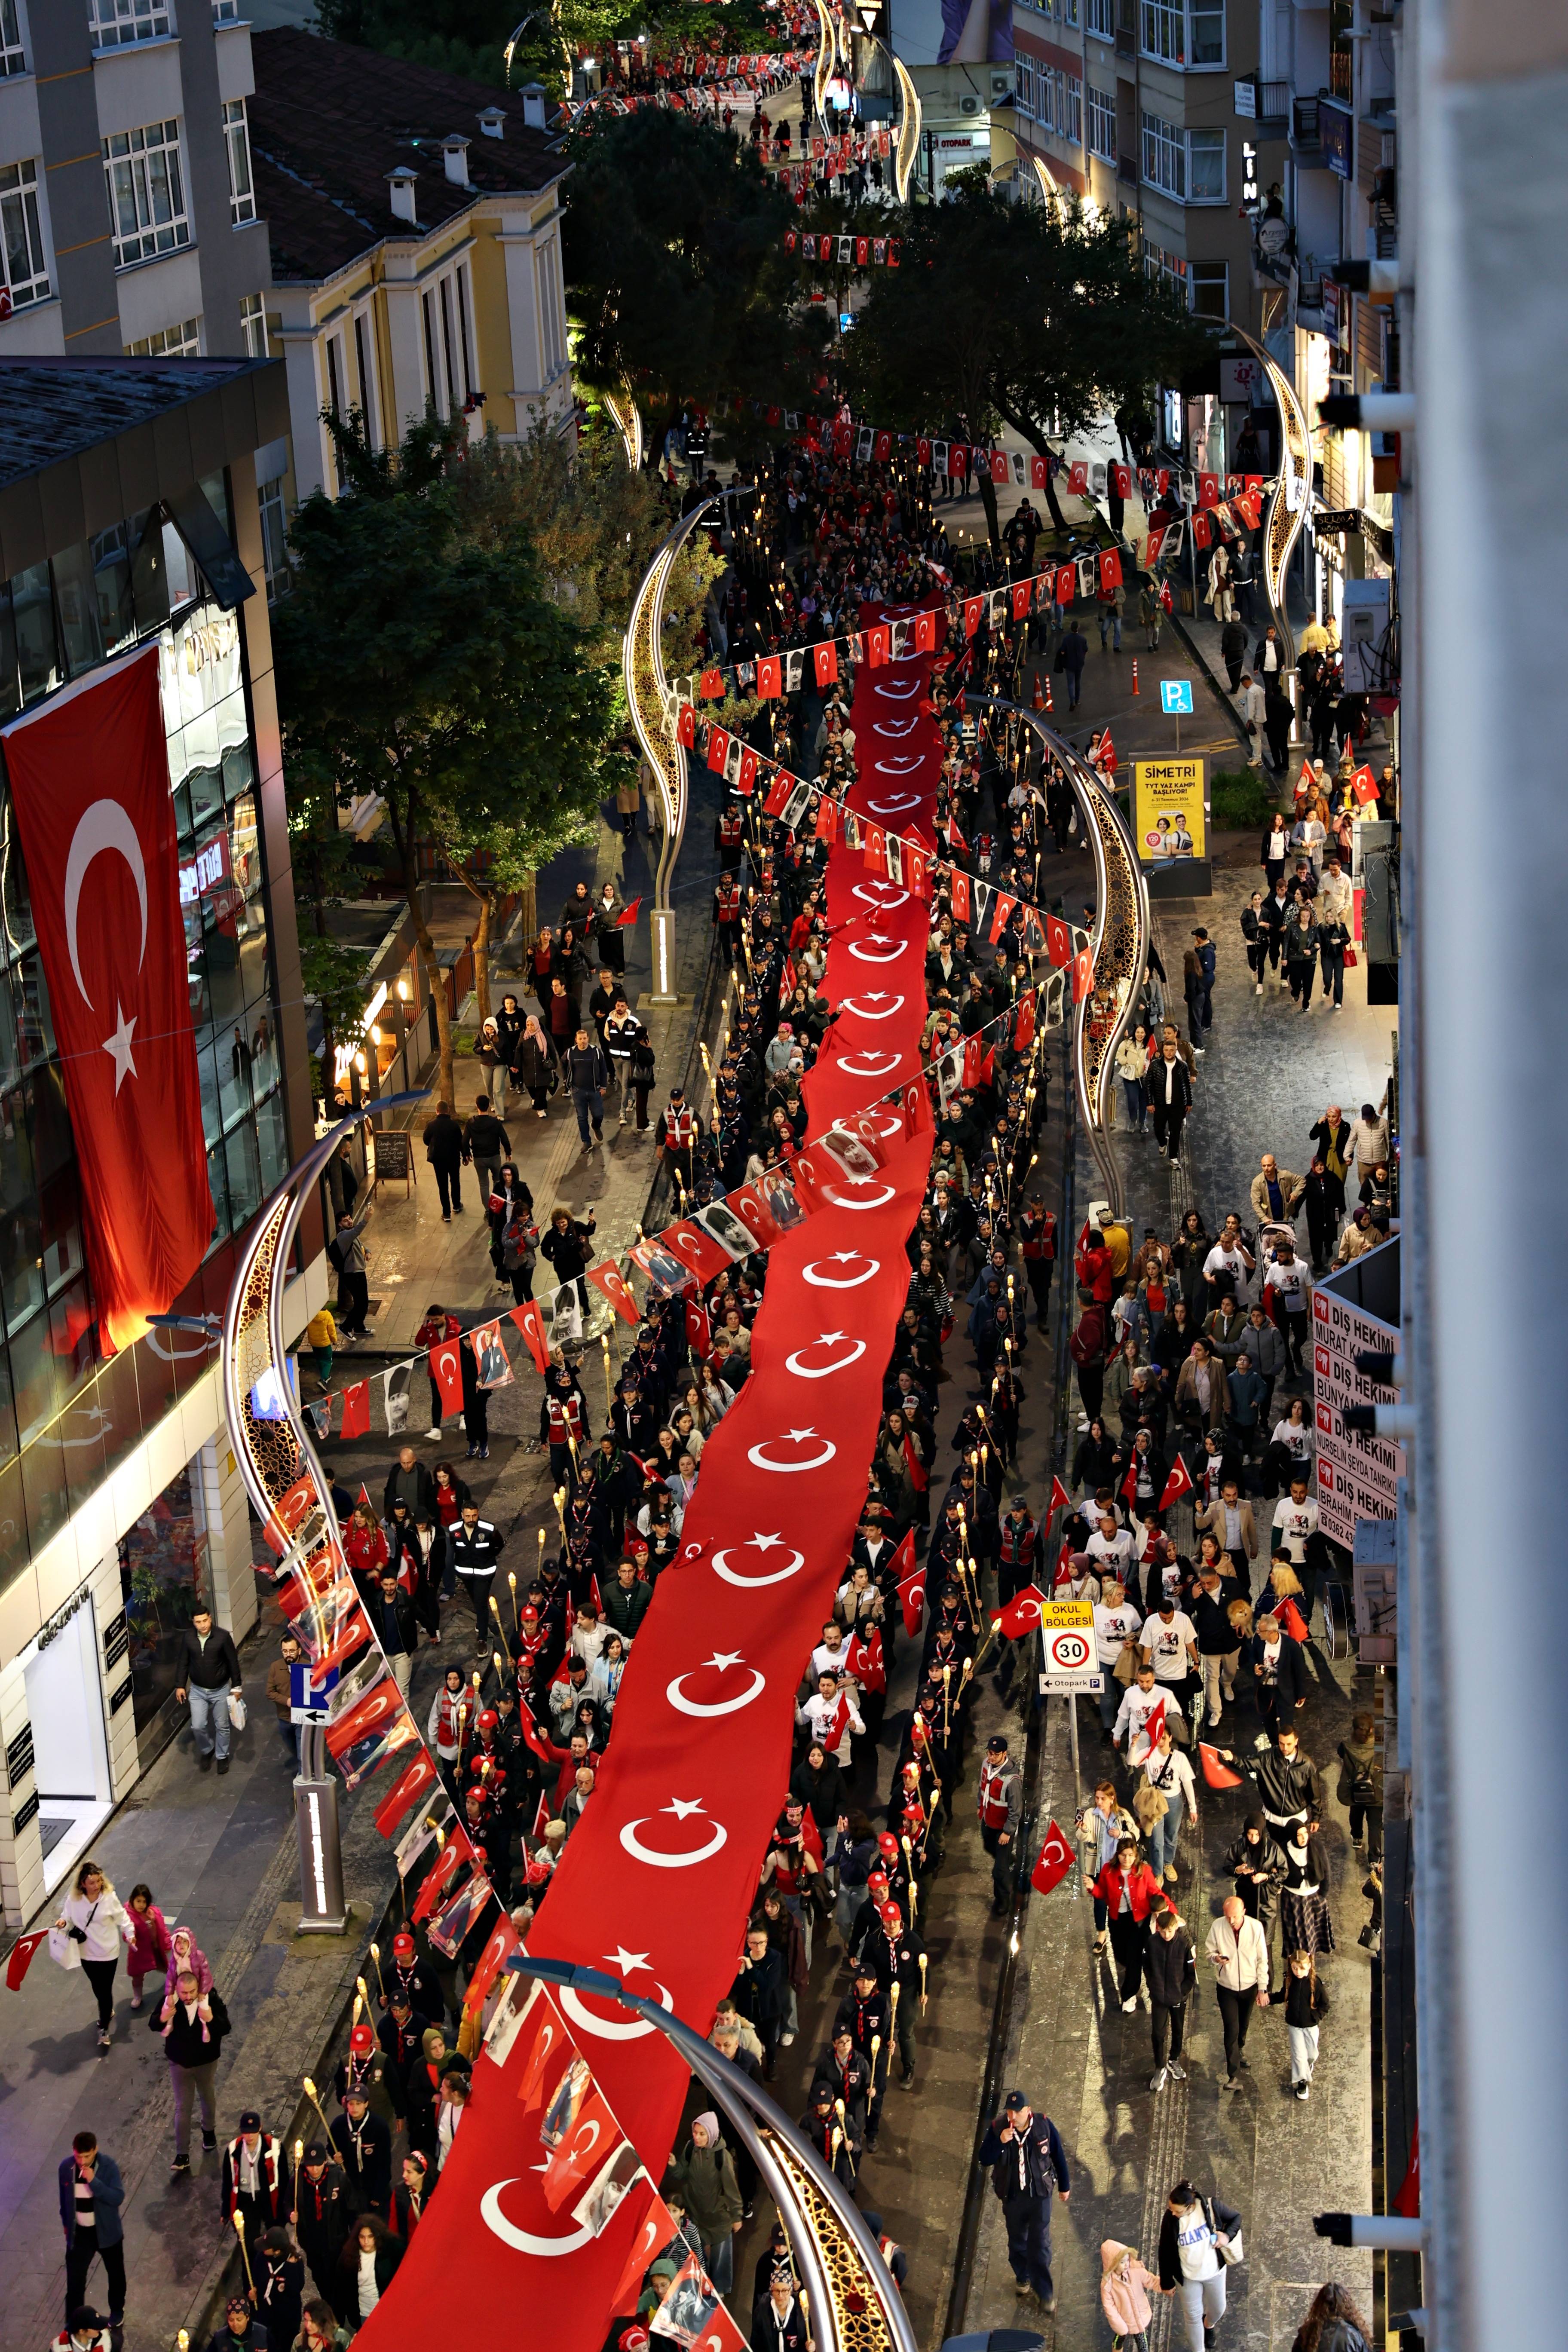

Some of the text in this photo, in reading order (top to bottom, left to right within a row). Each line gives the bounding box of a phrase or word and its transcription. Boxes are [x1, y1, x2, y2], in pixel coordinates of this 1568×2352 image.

[941, 138, 971, 147] OTOPARK
[1318, 513, 1354, 524] SELMA
[1166, 683, 1182, 707] P
[1145, 763, 1195, 778] SİMETRİ
[1316, 1321, 1347, 1355] MURAT
[1333, 1306, 1351, 1336] DİŞ
[1354, 1319, 1394, 1354] HEKİMİ
[1334, 1361, 1395, 1405] DİŞ HEKİMİ
[1335, 1418, 1396, 1472] DİŞ HEKİMİ
[1317, 1432, 1396, 1496] NURSELİN ŞEYDA TANRIKU
[1319, 1485, 1351, 1522] İBRAHİM
[1336, 1474, 1354, 1504] DİŞ
[1357, 1488, 1396, 1520] HEKİMİ
[1328, 1518, 1344, 1538] 0362
[1345, 1531, 1355, 1545] 43
[1046, 1615, 1092, 1626] BÖLGESİ
[1052, 1605, 1081, 1614] OKUL
[1060, 1643, 1082, 1658] 30
[303, 1668, 327, 1706] P
